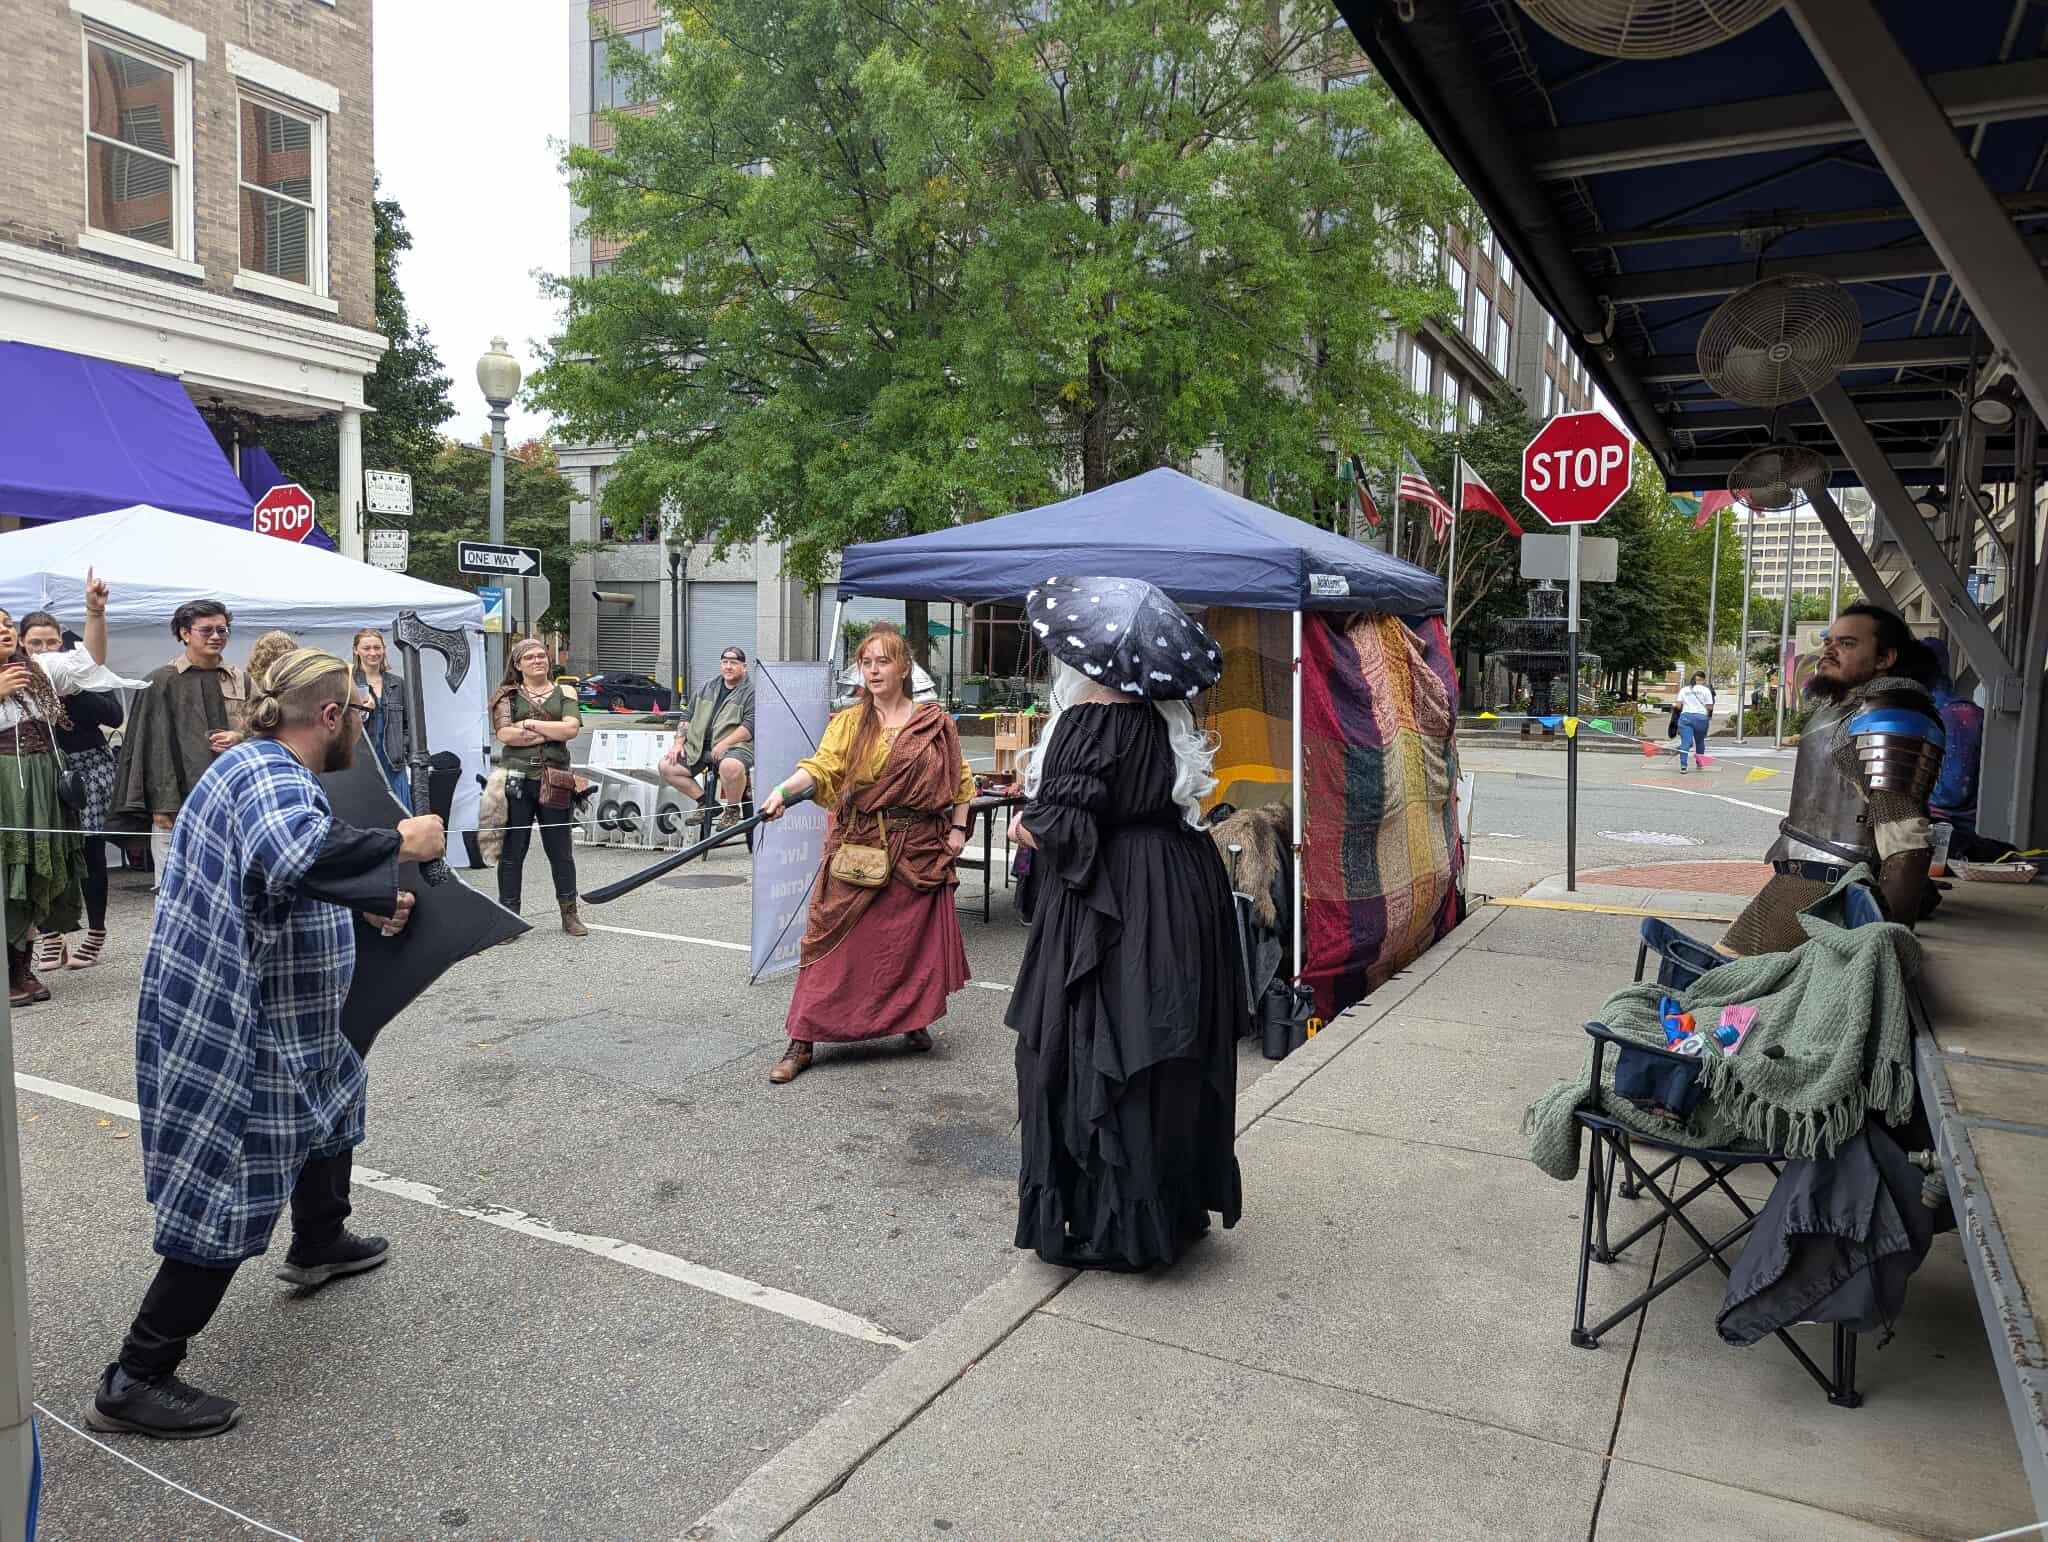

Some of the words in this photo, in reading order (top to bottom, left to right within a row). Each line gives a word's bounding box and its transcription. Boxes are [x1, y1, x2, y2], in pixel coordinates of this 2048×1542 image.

[1530, 445, 1623, 491] STOP
[258, 505, 310, 533] STOP
[467, 551, 489, 565] ONE
[494, 554, 516, 567] WAY
